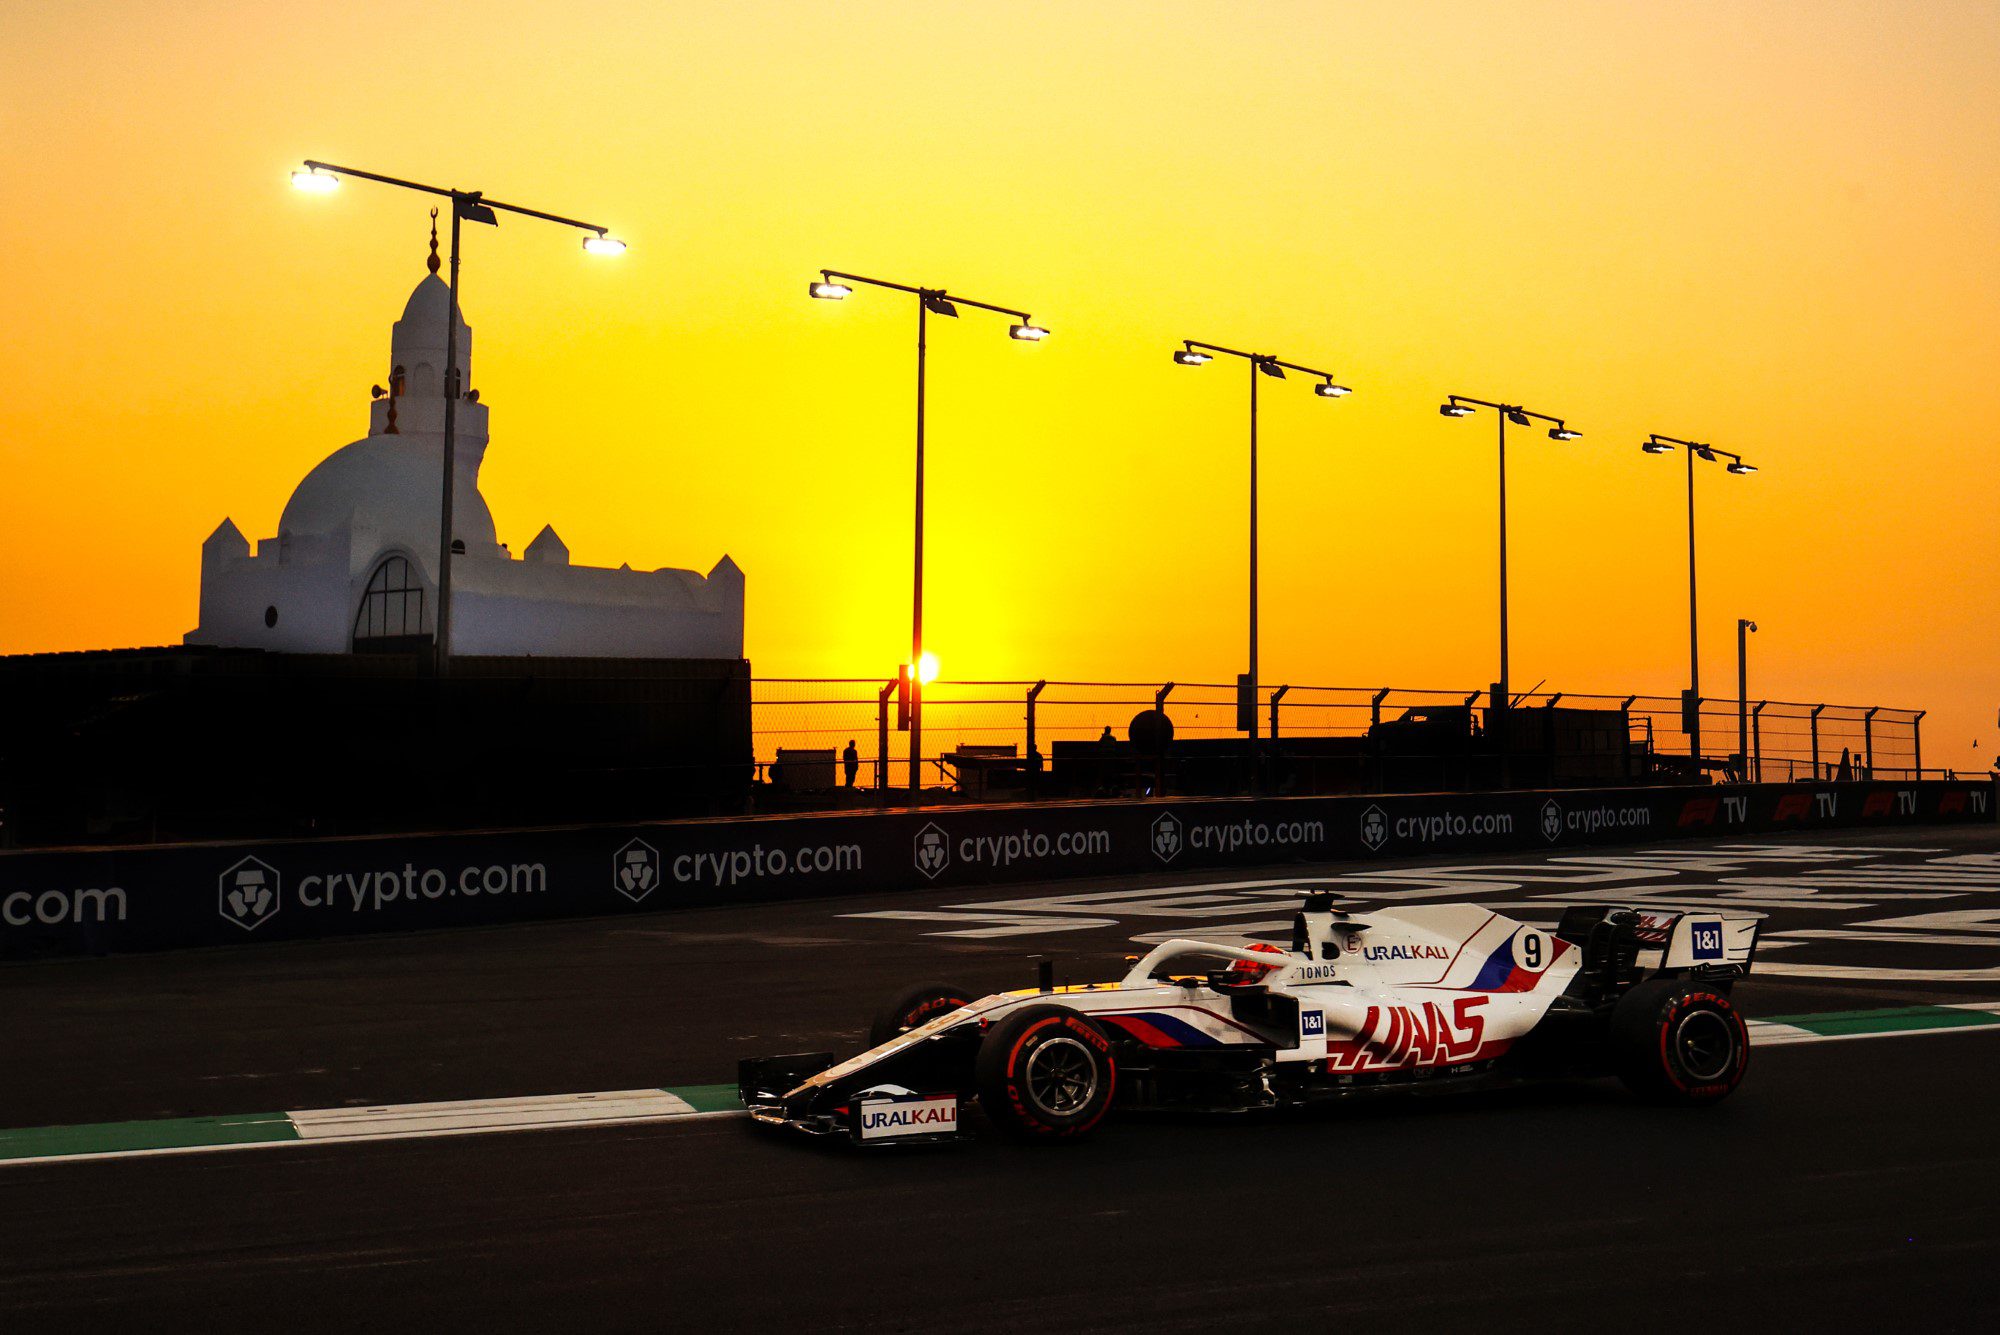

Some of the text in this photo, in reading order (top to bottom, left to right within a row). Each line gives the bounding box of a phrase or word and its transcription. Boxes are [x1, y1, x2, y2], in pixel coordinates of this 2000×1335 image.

[1723, 797, 1747, 824] TV
[1815, 792, 1837, 818] TV
[1897, 790, 1917, 815] TV
[1970, 790, 1987, 813] TV
[1395, 812, 1513, 841] crypto.com
[1567, 805, 1650, 832] crypto.com
[959, 829, 1109, 867] crypto.com
[1190, 820, 1324, 852] crypto.com
[673, 843, 862, 887] crypto.com
[299, 863, 546, 912] crypto.com
[1363, 944, 1450, 961] URALKALI
[1523, 933, 1543, 968] 9
[1694, 930, 1719, 950] 1&1
[1301, 964, 1336, 980] IONOS
[1303, 1015, 1322, 1029] 1&1
[1330, 995, 1490, 1070] HAAS
[863, 1107, 955, 1129] URALKALI
